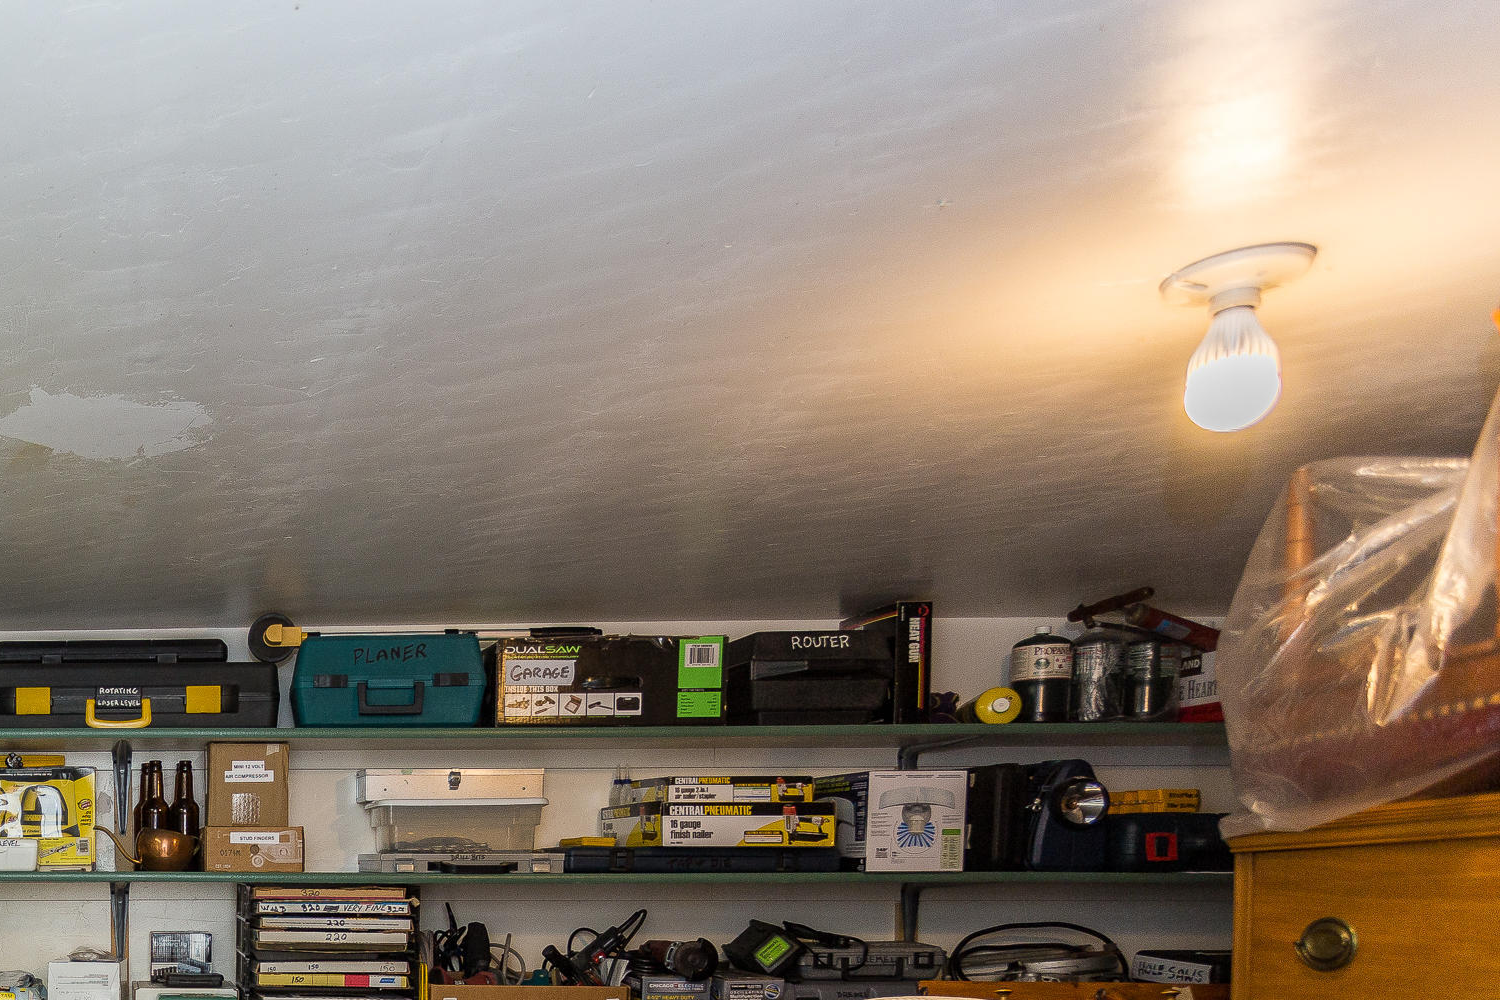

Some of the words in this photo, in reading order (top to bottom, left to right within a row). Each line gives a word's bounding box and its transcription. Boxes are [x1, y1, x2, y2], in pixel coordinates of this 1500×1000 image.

[909, 617, 920, 641] HEAT
[791, 635, 850, 650] ROUTER
[353, 643, 428, 665] PLANER
[908, 642, 920, 663] GUN
[510, 665, 570, 681] GARAGE
[670, 820, 678, 828] 16
[680, 820, 702, 830] gauge
[670, 830, 691, 840] finish
[692, 830, 714, 840] nailer
[300, 889, 320, 897] 320
[365, 904, 386, 912] FINE
[326, 933, 348, 942] 220
[292, 976, 304, 984] 150
